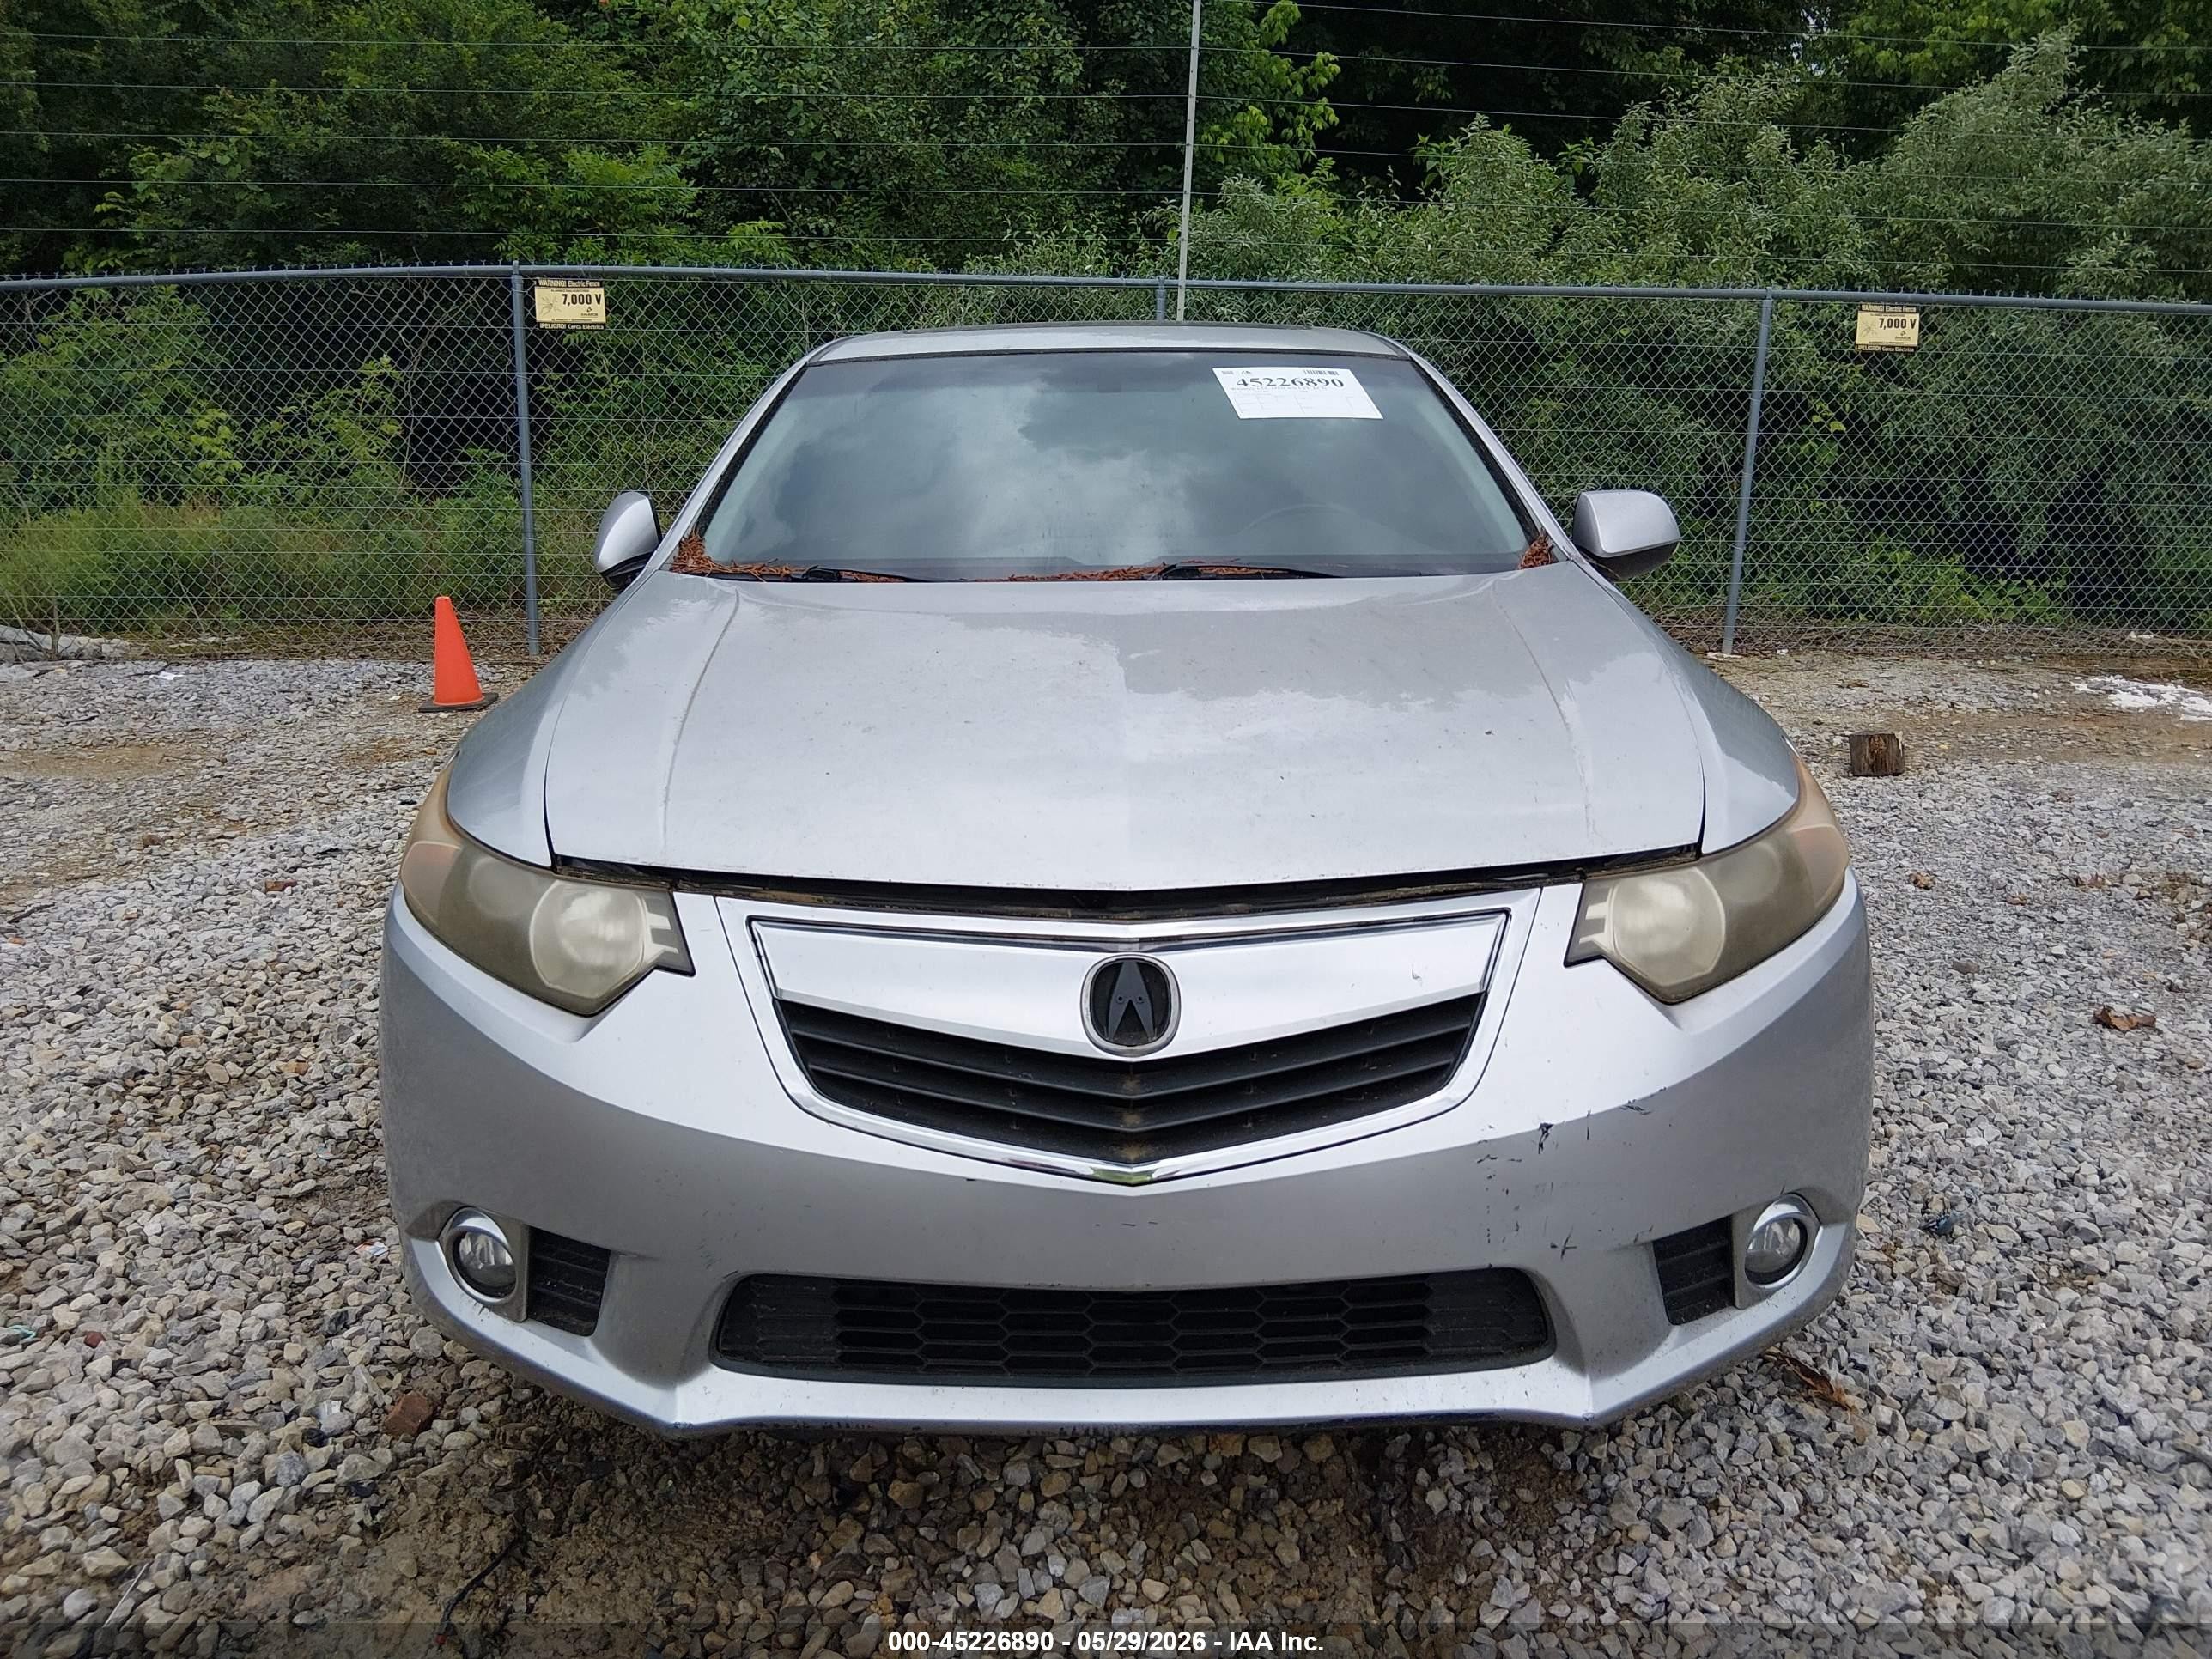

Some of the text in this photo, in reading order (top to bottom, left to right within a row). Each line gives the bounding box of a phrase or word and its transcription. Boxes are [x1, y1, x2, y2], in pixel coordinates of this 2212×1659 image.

[562, 293, 602, 307] 7,000 V
[1879, 318, 1917, 330] 7,000 V
[1237, 376, 1345, 388] 45226890
